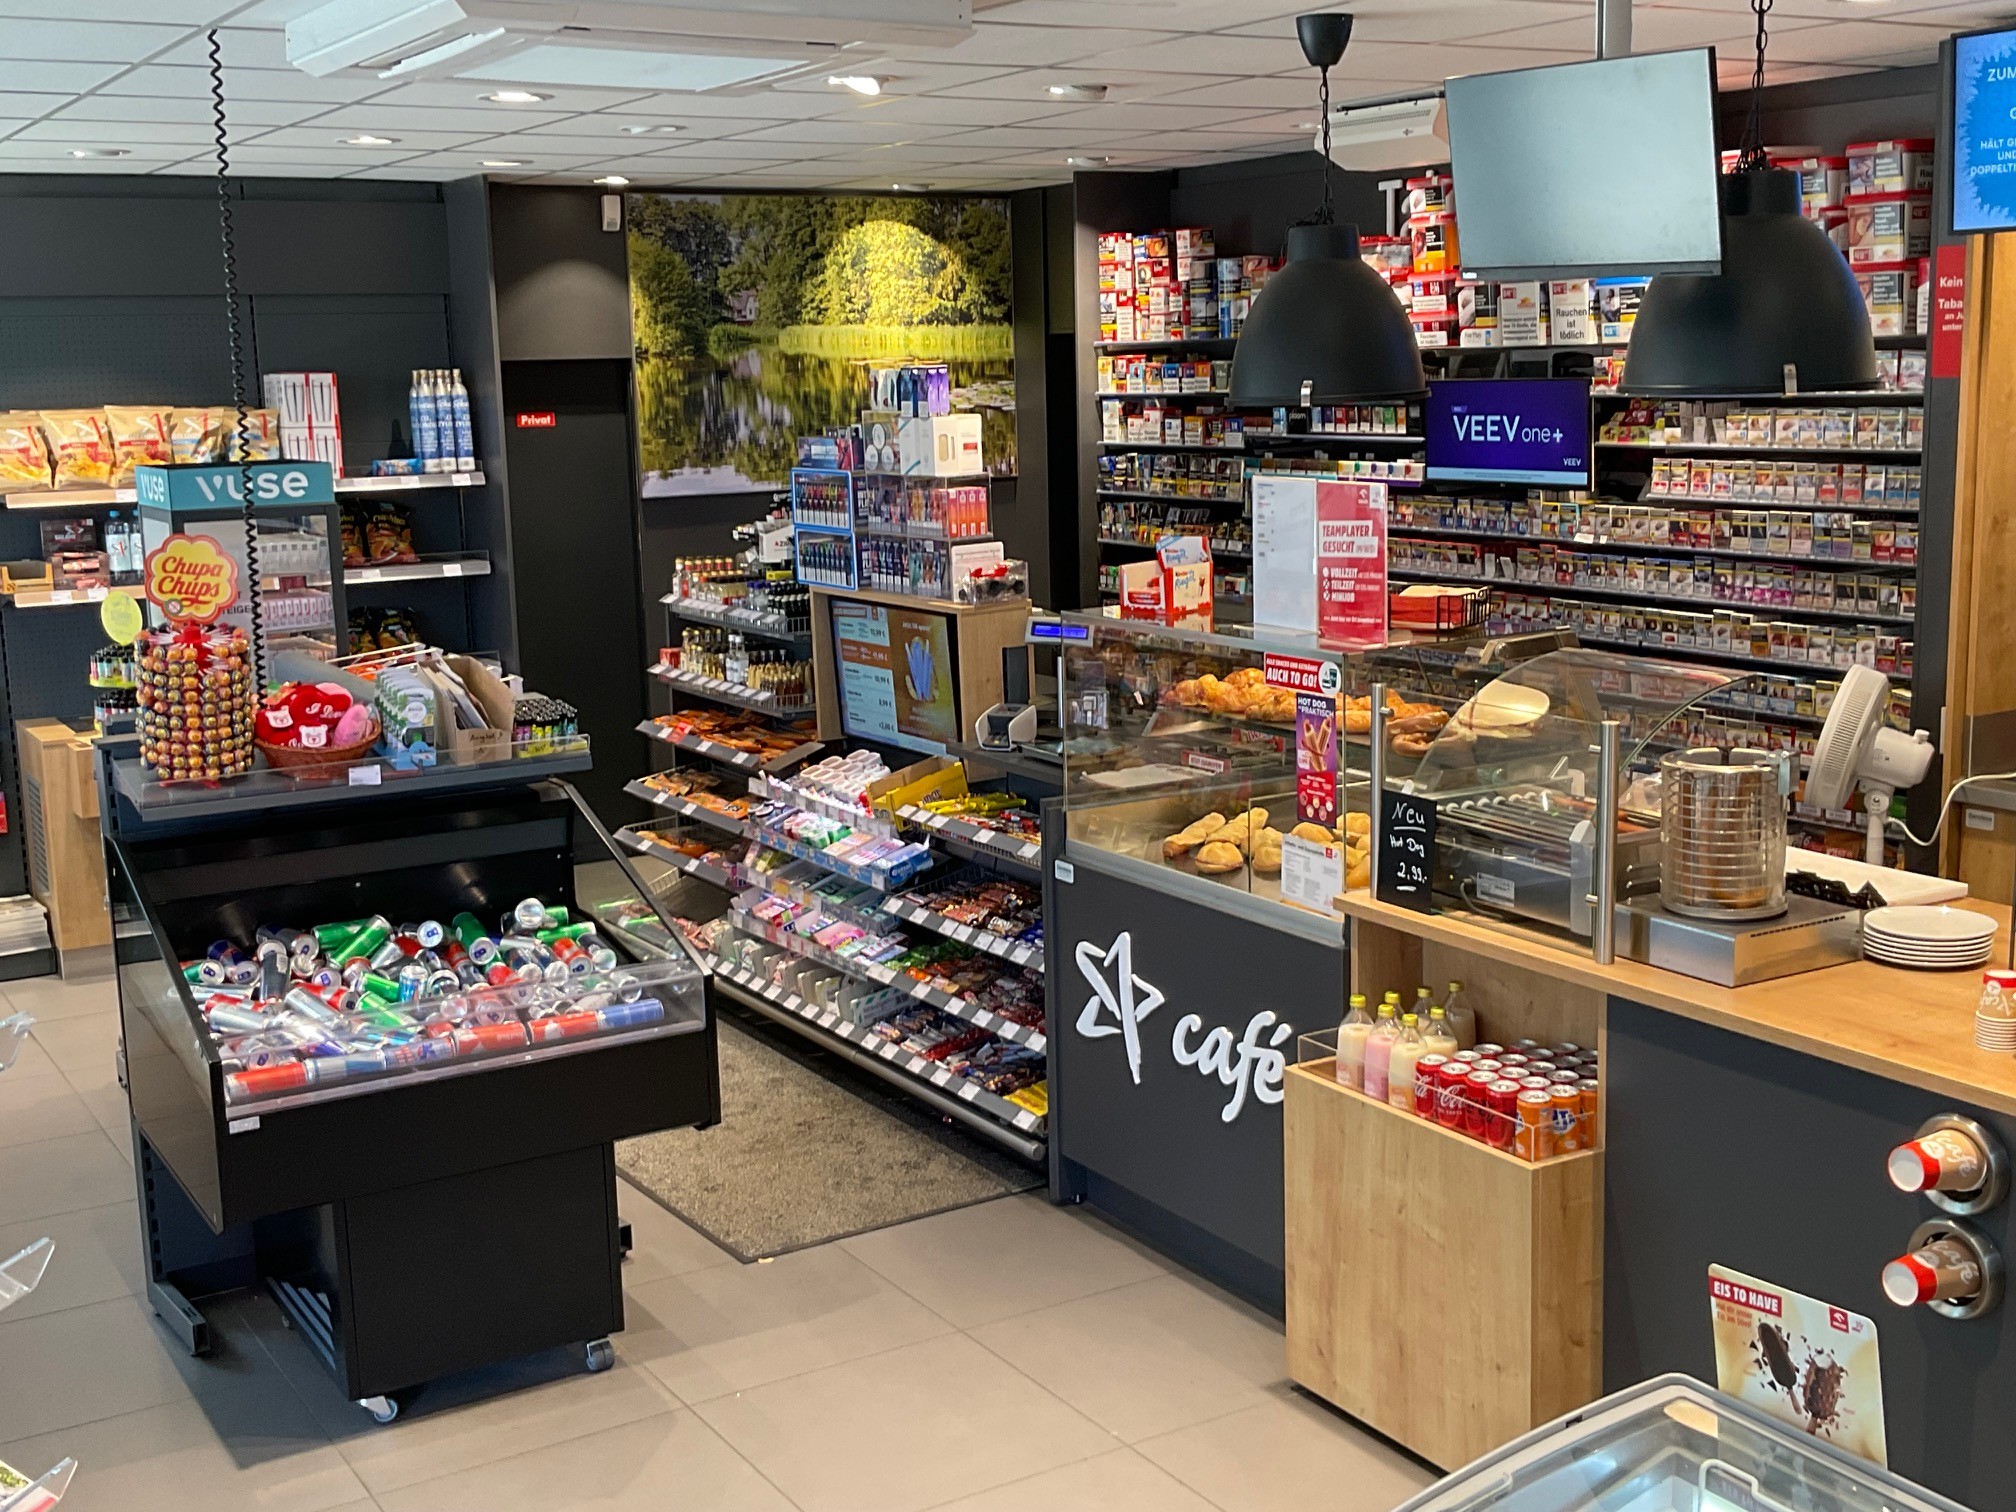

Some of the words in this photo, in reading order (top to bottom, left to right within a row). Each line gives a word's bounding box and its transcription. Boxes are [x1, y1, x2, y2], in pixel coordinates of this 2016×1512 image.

[1981, 138, 2003, 149] HÄLT
[1940, 276, 1963, 287] Kein
[1556, 308, 1587, 317] Rauchen
[1566, 319, 1576, 327] ist
[1560, 330, 1584, 339] tödlich
[521, 416, 551, 425] Privat
[1453, 415, 1520, 441] VEEV
[1563, 458, 1581, 466] VEEV
[1322, 525, 1370, 537] TEAMPLAYER
[1323, 541, 1354, 553] GESUCHT
[162, 556, 224, 579] Chupa
[1330, 567, 1358, 578] VOLLZEIT
[158, 575, 220, 598] Chups
[1331, 581, 1355, 590] TEILZEIT
[1267, 668, 1288, 683] AUCH
[1290, 671, 1300, 685] TO
[1302, 673, 1317, 688] GO!
[1298, 697, 1311, 706] HOT
[1312, 699, 1326, 708] DOG
[1302, 707, 1334, 718] PRAKTISCH
[1392, 802, 1425, 824] Neu
[1390, 834, 1403, 848] Hot
[1406, 838, 1424, 858] Dog
[1172, 1010, 1292, 1122] café
[1714, 1281, 1730, 1298] EIS
[1733, 1287, 1747, 1302] TO
[1749, 1291, 1778, 1312] HAVE
